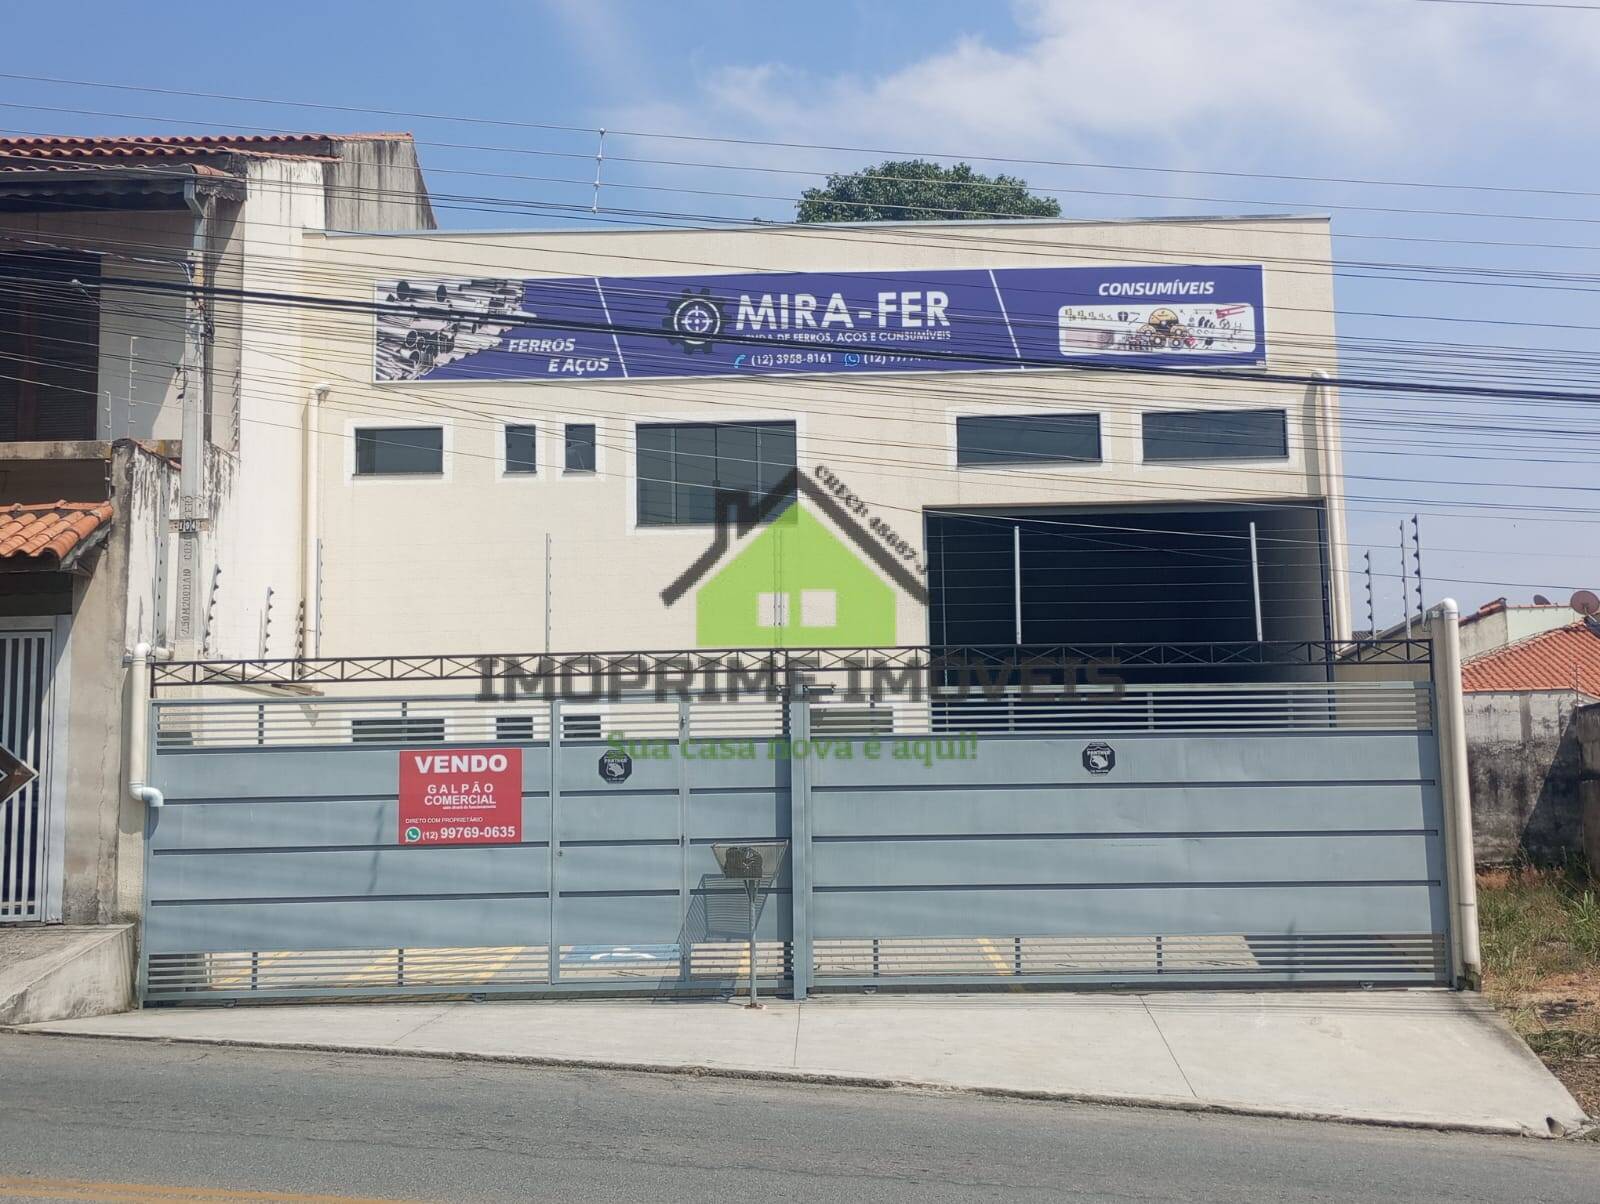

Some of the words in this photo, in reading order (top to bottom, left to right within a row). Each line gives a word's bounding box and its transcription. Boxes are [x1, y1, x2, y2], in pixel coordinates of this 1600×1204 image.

[1098, 279, 1215, 296] CONSUMÍVEIS
[736, 291, 951, 331] MIRA-FER
[837, 331, 870, 343] AÇOS
[870, 332, 876, 341] E
[879, 329, 951, 341] CONSUMÍVEIS
[508, 338, 576, 352] FERROS
[548, 359, 559, 372] E
[562, 357, 610, 375] AÇOS
[751, 354, 773, 367] (12)
[776, 353, 832, 364] 3958-8161
[415, 754, 508, 774] VENDO
[427, 781, 494, 795] GALPÃO
[424, 795, 496, 806] COMERCIAL
[422, 832, 439, 841] (12)
[440, 826, 516, 839] 99769-0635
